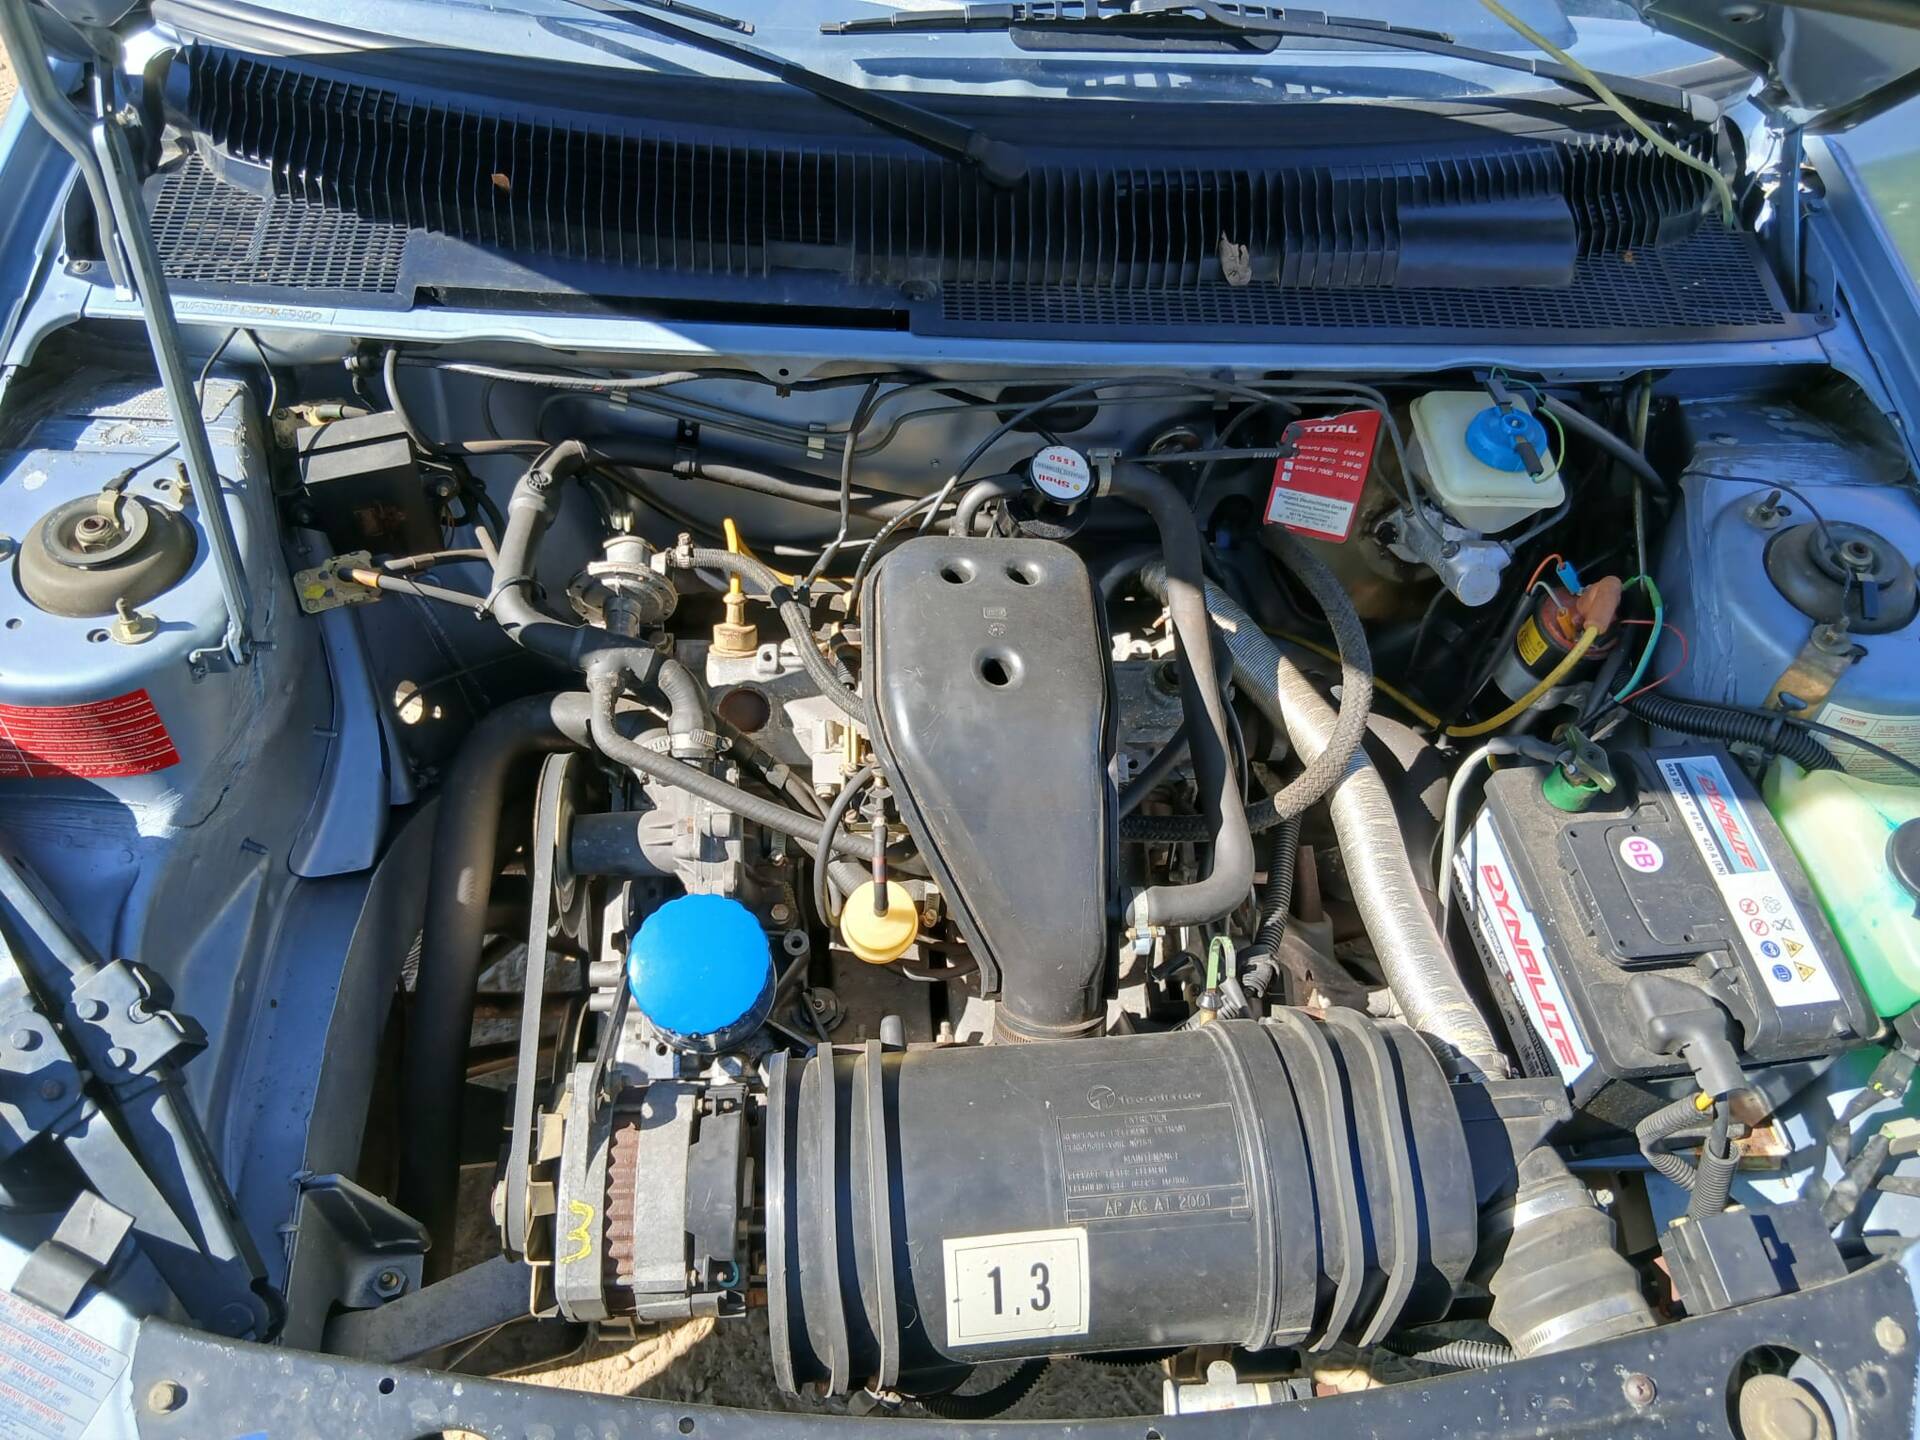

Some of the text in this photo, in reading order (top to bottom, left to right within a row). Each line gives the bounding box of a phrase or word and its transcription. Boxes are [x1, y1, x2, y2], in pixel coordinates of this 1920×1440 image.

[1304, 424, 1358, 434] TOTAL
[1039, 474, 1070, 488] Shell
[1679, 791, 1690, 800] 12
[1698, 776, 1759, 872] DYNALITE
[1627, 839, 1657, 869] 6B
[1480, 863, 1581, 1068] DYNALITE
[1123, 1151, 1179, 1163] MAINTENANCE
[560, 1199, 594, 1264] 3
[987, 1262, 1051, 1316] 1.3
